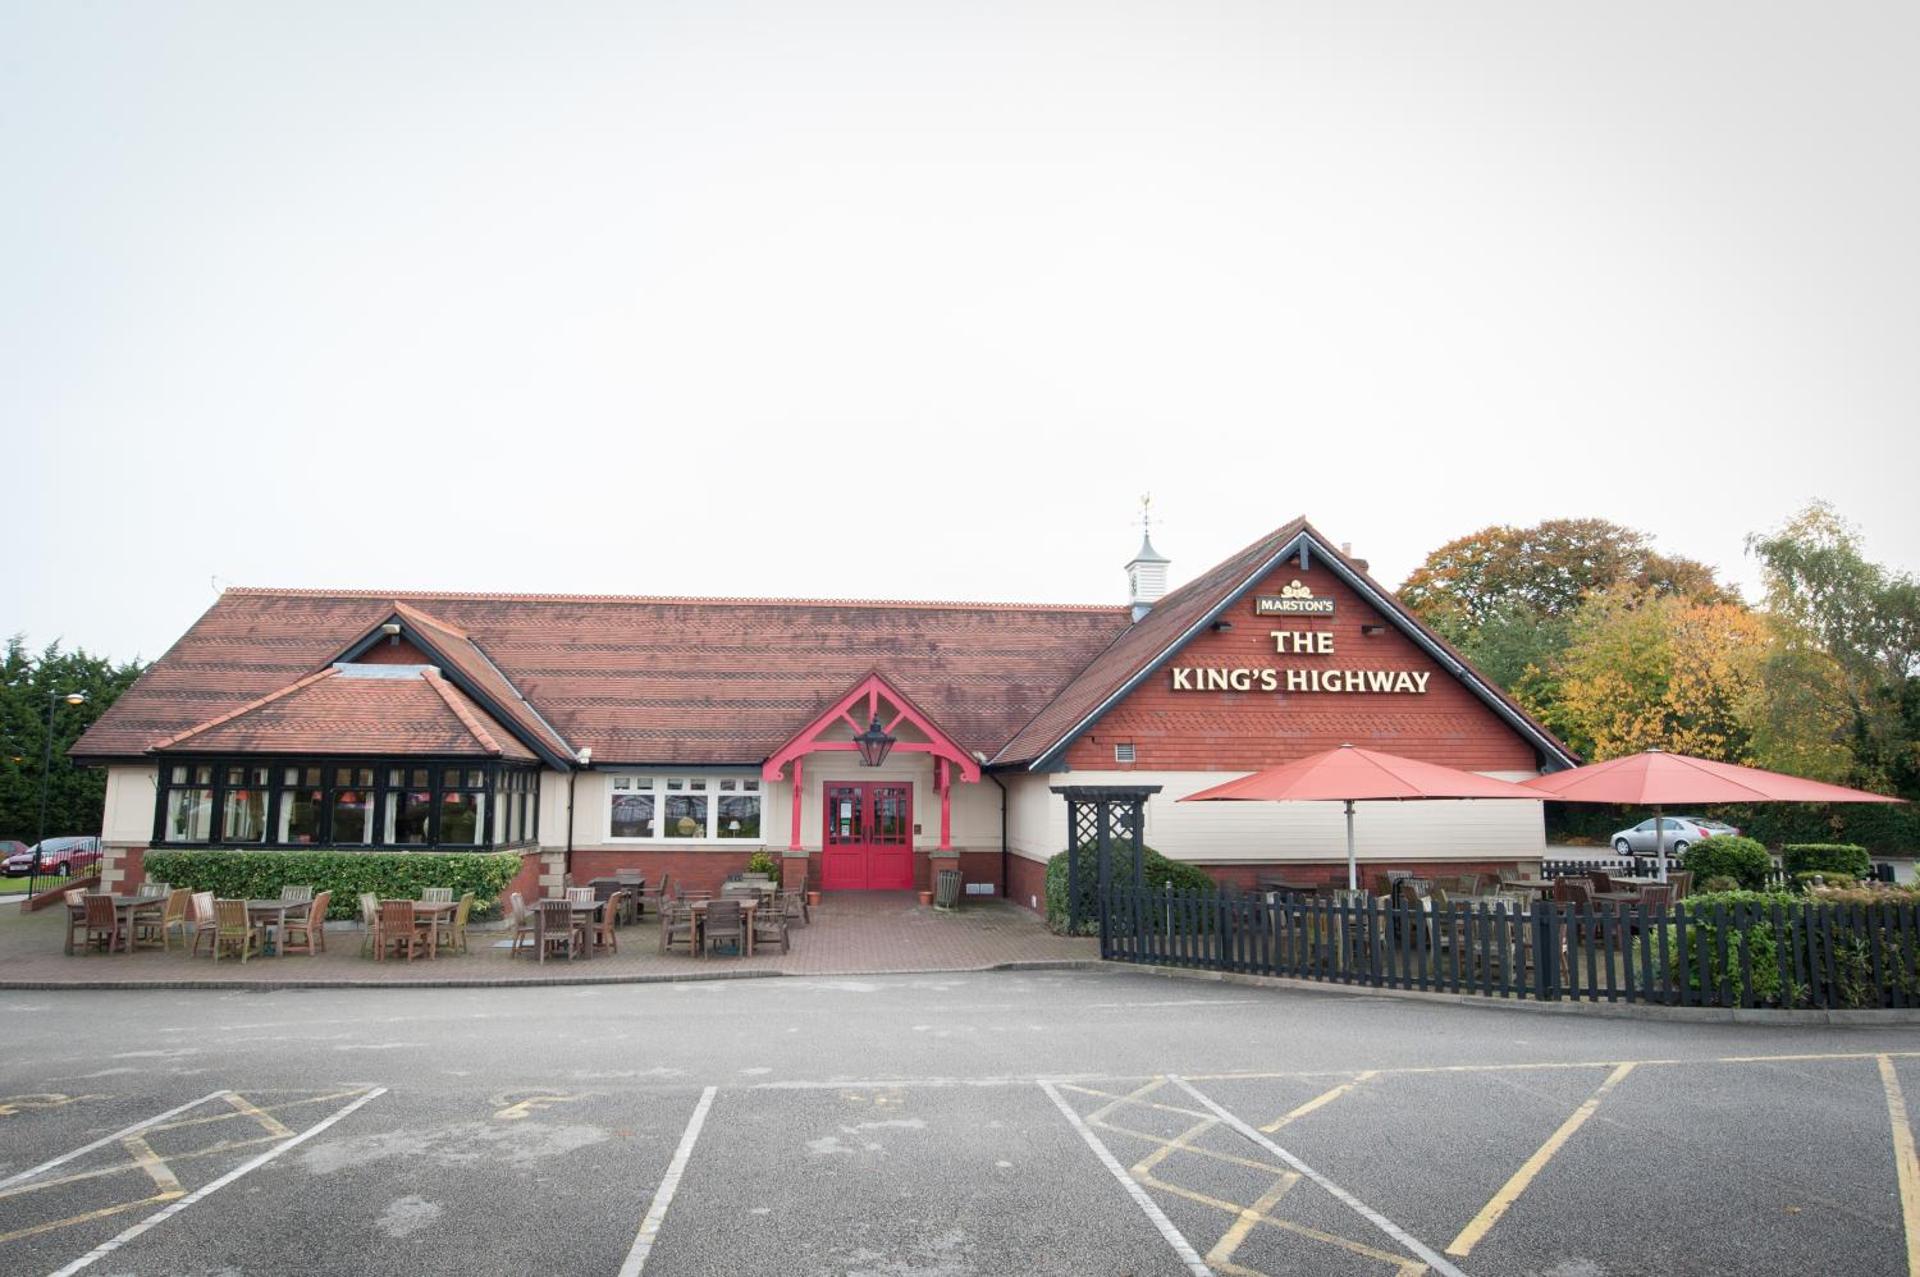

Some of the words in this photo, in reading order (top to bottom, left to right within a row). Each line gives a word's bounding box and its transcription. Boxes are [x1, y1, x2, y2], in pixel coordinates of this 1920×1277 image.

[1261, 599, 1334, 612] MARSTON'S
[1271, 631, 1335, 654] THE
[1173, 667, 1278, 691] KING'S
[1286, 669, 1431, 693] HIGHWAY
